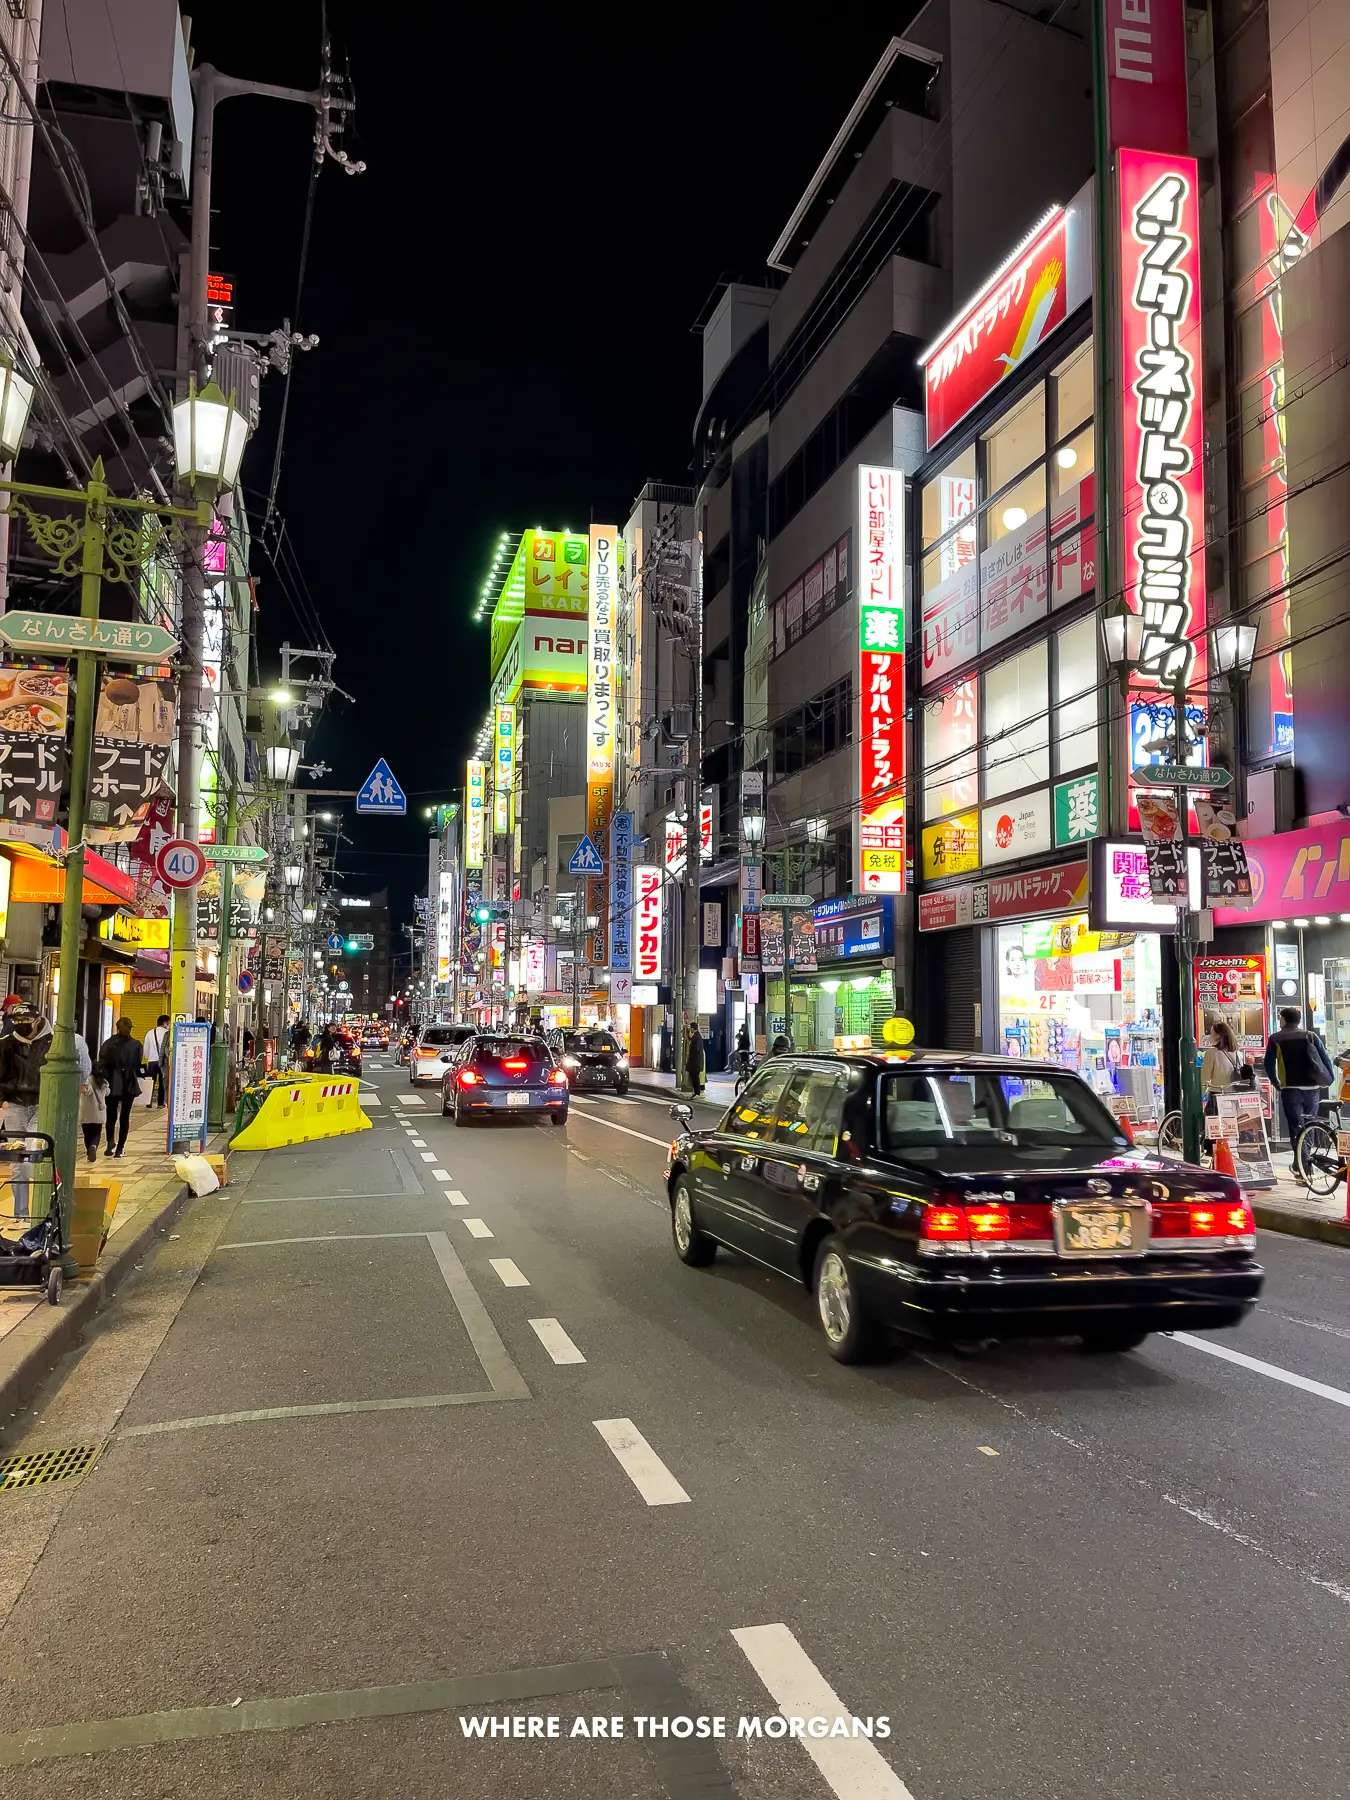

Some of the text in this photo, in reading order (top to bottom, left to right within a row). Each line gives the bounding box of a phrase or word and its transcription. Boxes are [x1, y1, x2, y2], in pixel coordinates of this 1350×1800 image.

[868, 472, 885, 600] いい部屋ネット
[963, 542, 1023, 597] お部屋さがしは
[542, 595, 588, 613] KAR
[923, 544, 1078, 669] いい部屋ネット
[21, 618, 153, 648] なんさん通り
[864, 609, 899, 648] 薬
[592, 628, 613, 747] 買取りまっくす
[870, 654, 894, 795] ツルハドラッグ
[95, 737, 168, 750] コミュニティー
[95, 748, 166, 776] フード
[91, 772, 162, 799] ホール
[1154, 767, 1222, 784] なんさん通り
[592, 787, 608, 796] 5F
[1067, 780, 1098, 840] 薬
[168, 853, 195, 875] 40
[202, 846, 258, 858] なんさん通り
[869, 854, 896, 868] 免税
[1147, 845, 1183, 861] フード
[1204, 846, 1243, 862] フード
[1149, 861, 1188, 877] ホール
[1208, 863, 1249, 878] ホール
[992, 871, 1064, 904] ツルハドラッグ
[974, 886, 988, 917] 薬
[639, 873, 659, 975] ジャンカラ
[761, 938, 782, 948] フード
[793, 938, 815, 947] フード
[1040, 995, 1057, 1010] 2F
[191, 1045, 203, 1105] 貨物専用
